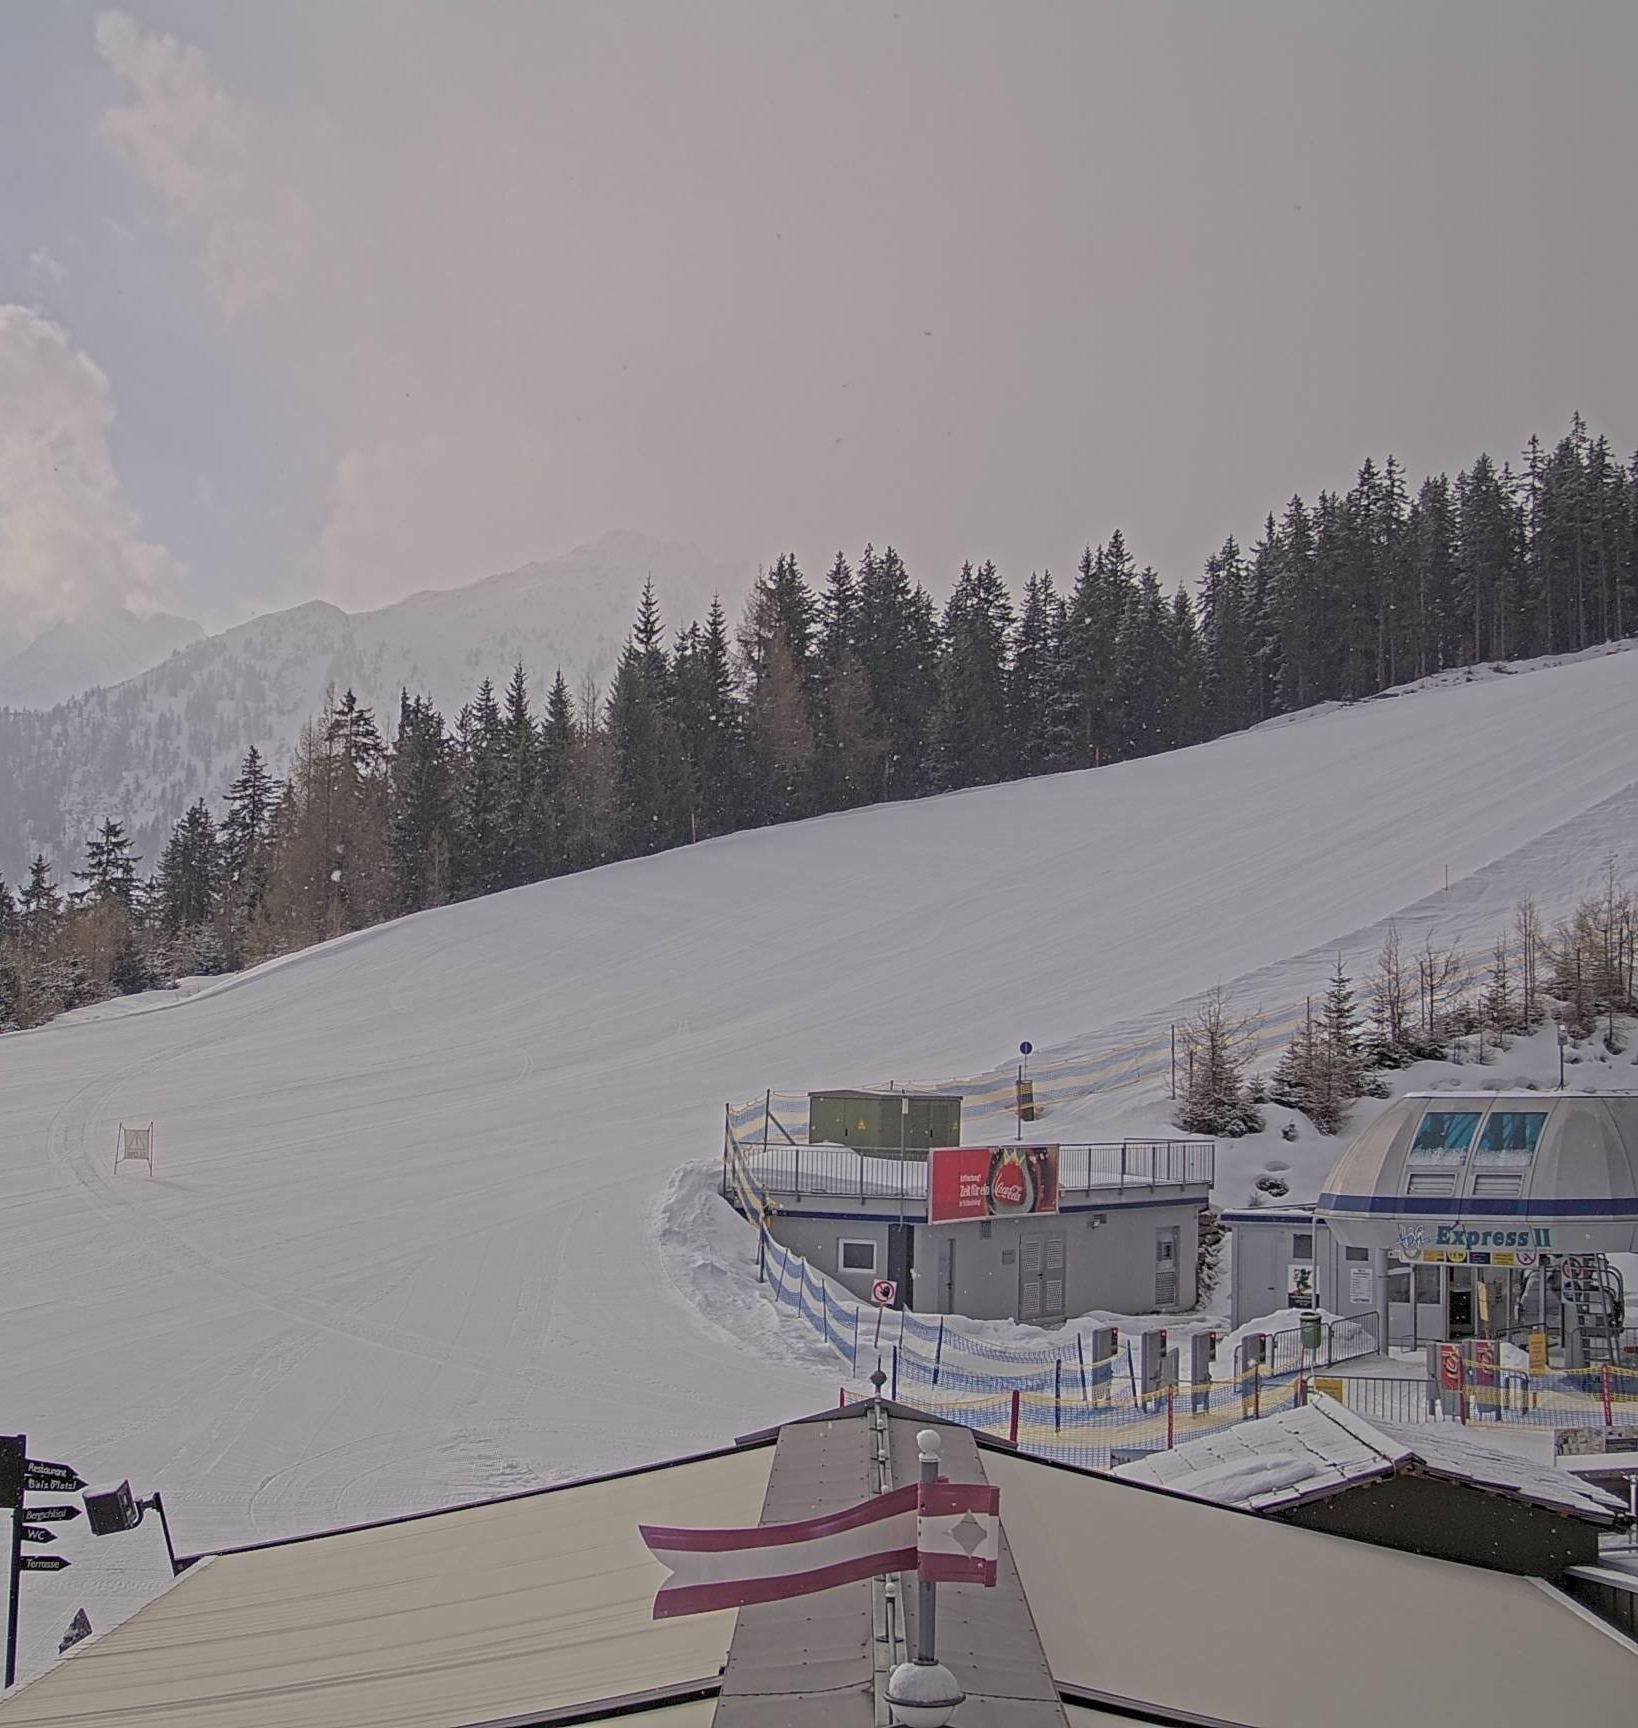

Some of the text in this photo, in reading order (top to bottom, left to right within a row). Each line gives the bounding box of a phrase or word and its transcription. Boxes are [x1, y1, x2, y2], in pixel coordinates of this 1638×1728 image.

[1436, 1225, 1529, 1250] Express
[1533, 1228, 1551, 1247] II
[27, 1463, 67, 1477] Restaurant
[27, 1530, 46, 1540] WC
[26, 1560, 60, 1569] Terrasse
